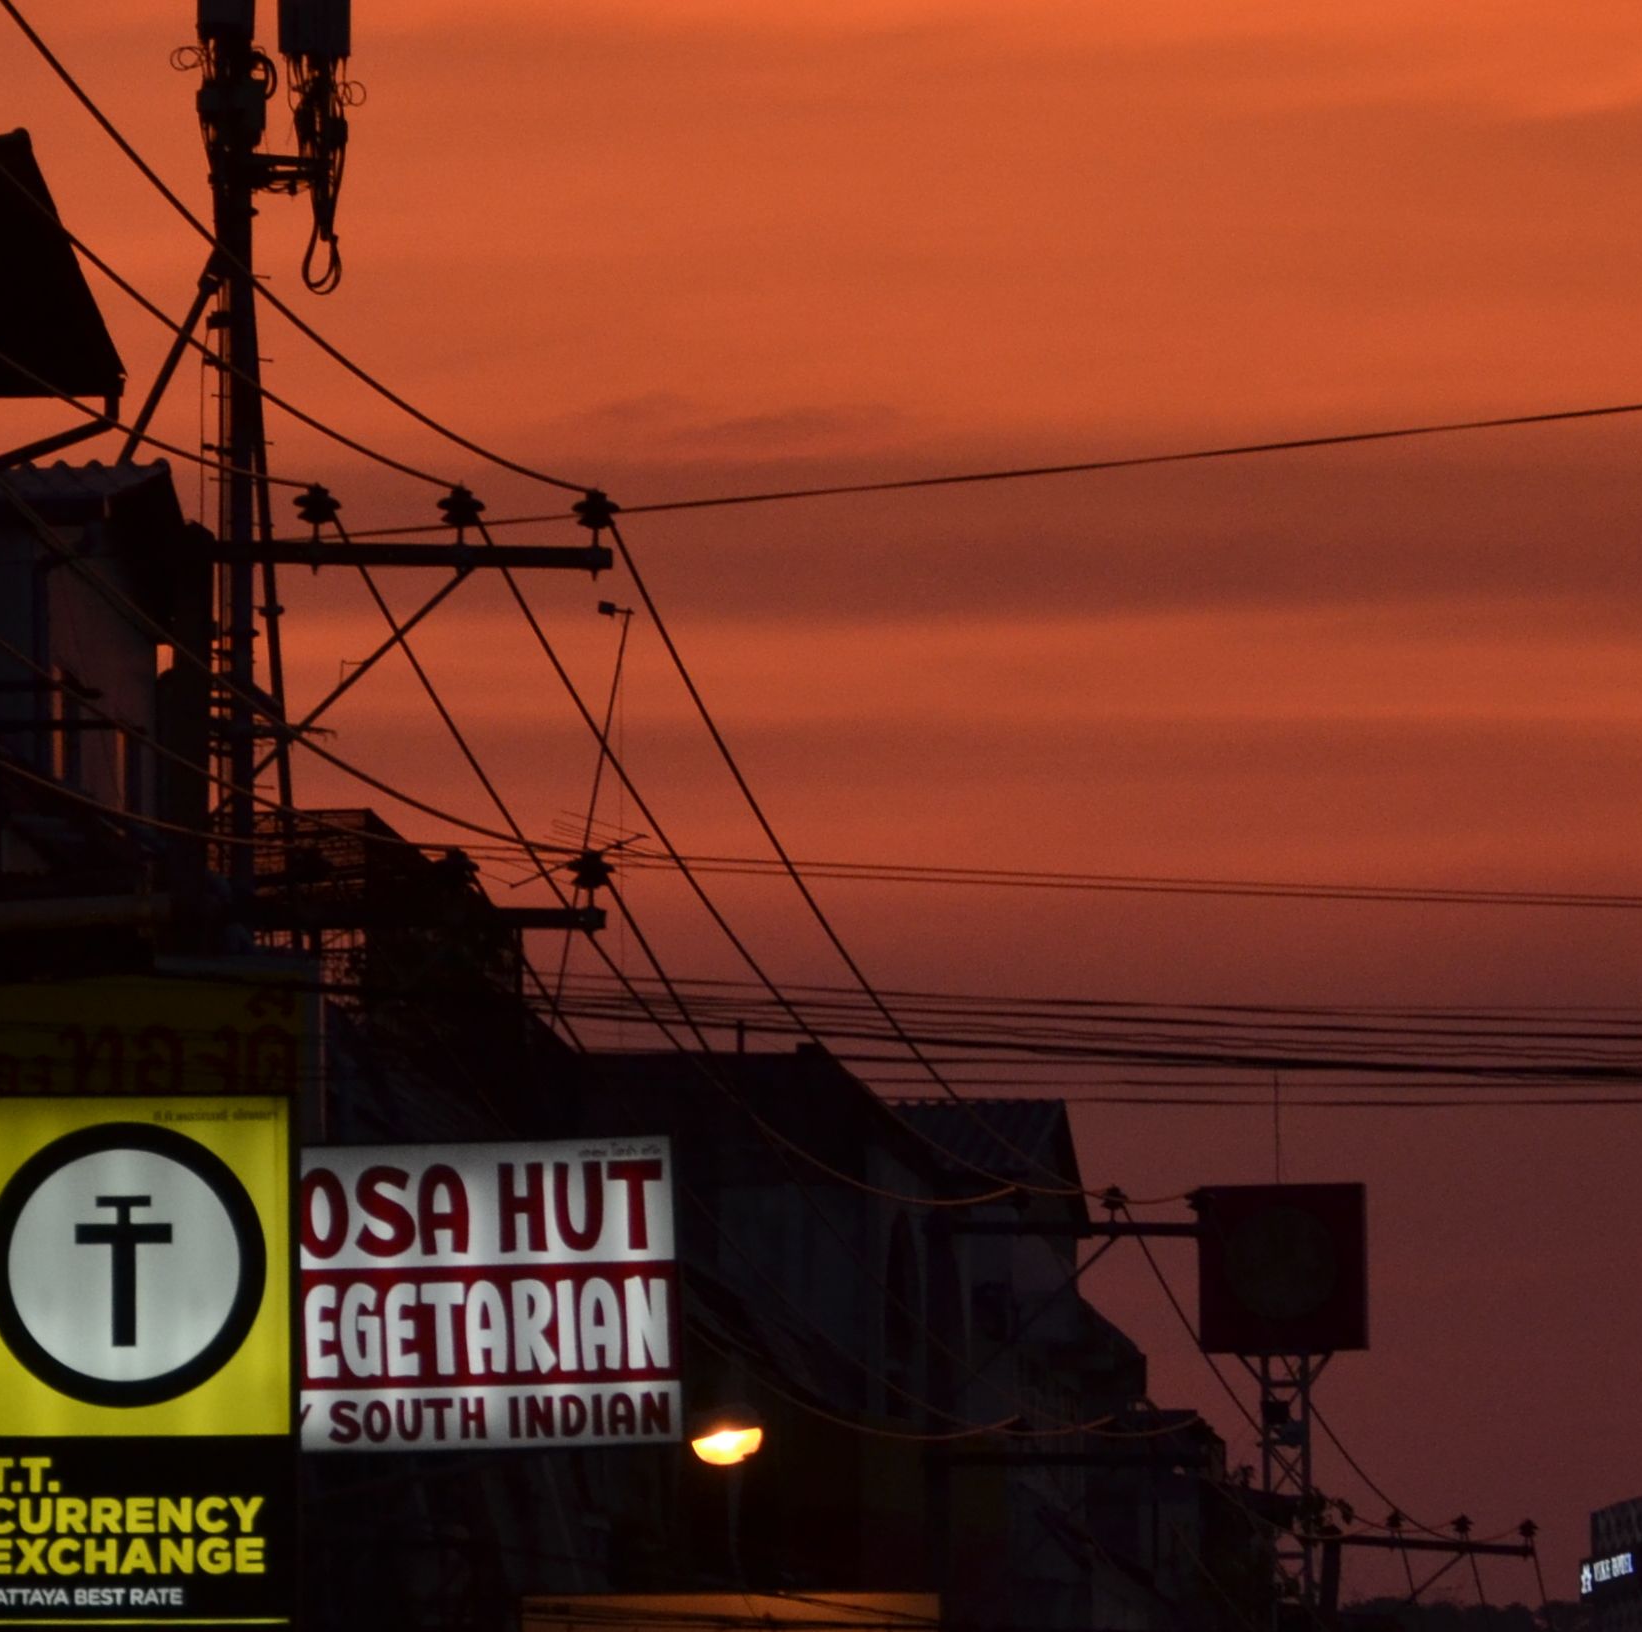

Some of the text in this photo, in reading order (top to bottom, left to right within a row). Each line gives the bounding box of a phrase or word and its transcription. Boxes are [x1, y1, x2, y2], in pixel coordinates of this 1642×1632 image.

[300, 1159, 662, 1258] OSA HUT
[303, 1275, 672, 1379] EGETARIAN
[329, 1392, 671, 1443] SOUTH INDIAN
[74, 1587, 126, 1606] BEST
[130, 1587, 183, 1606] RATE
